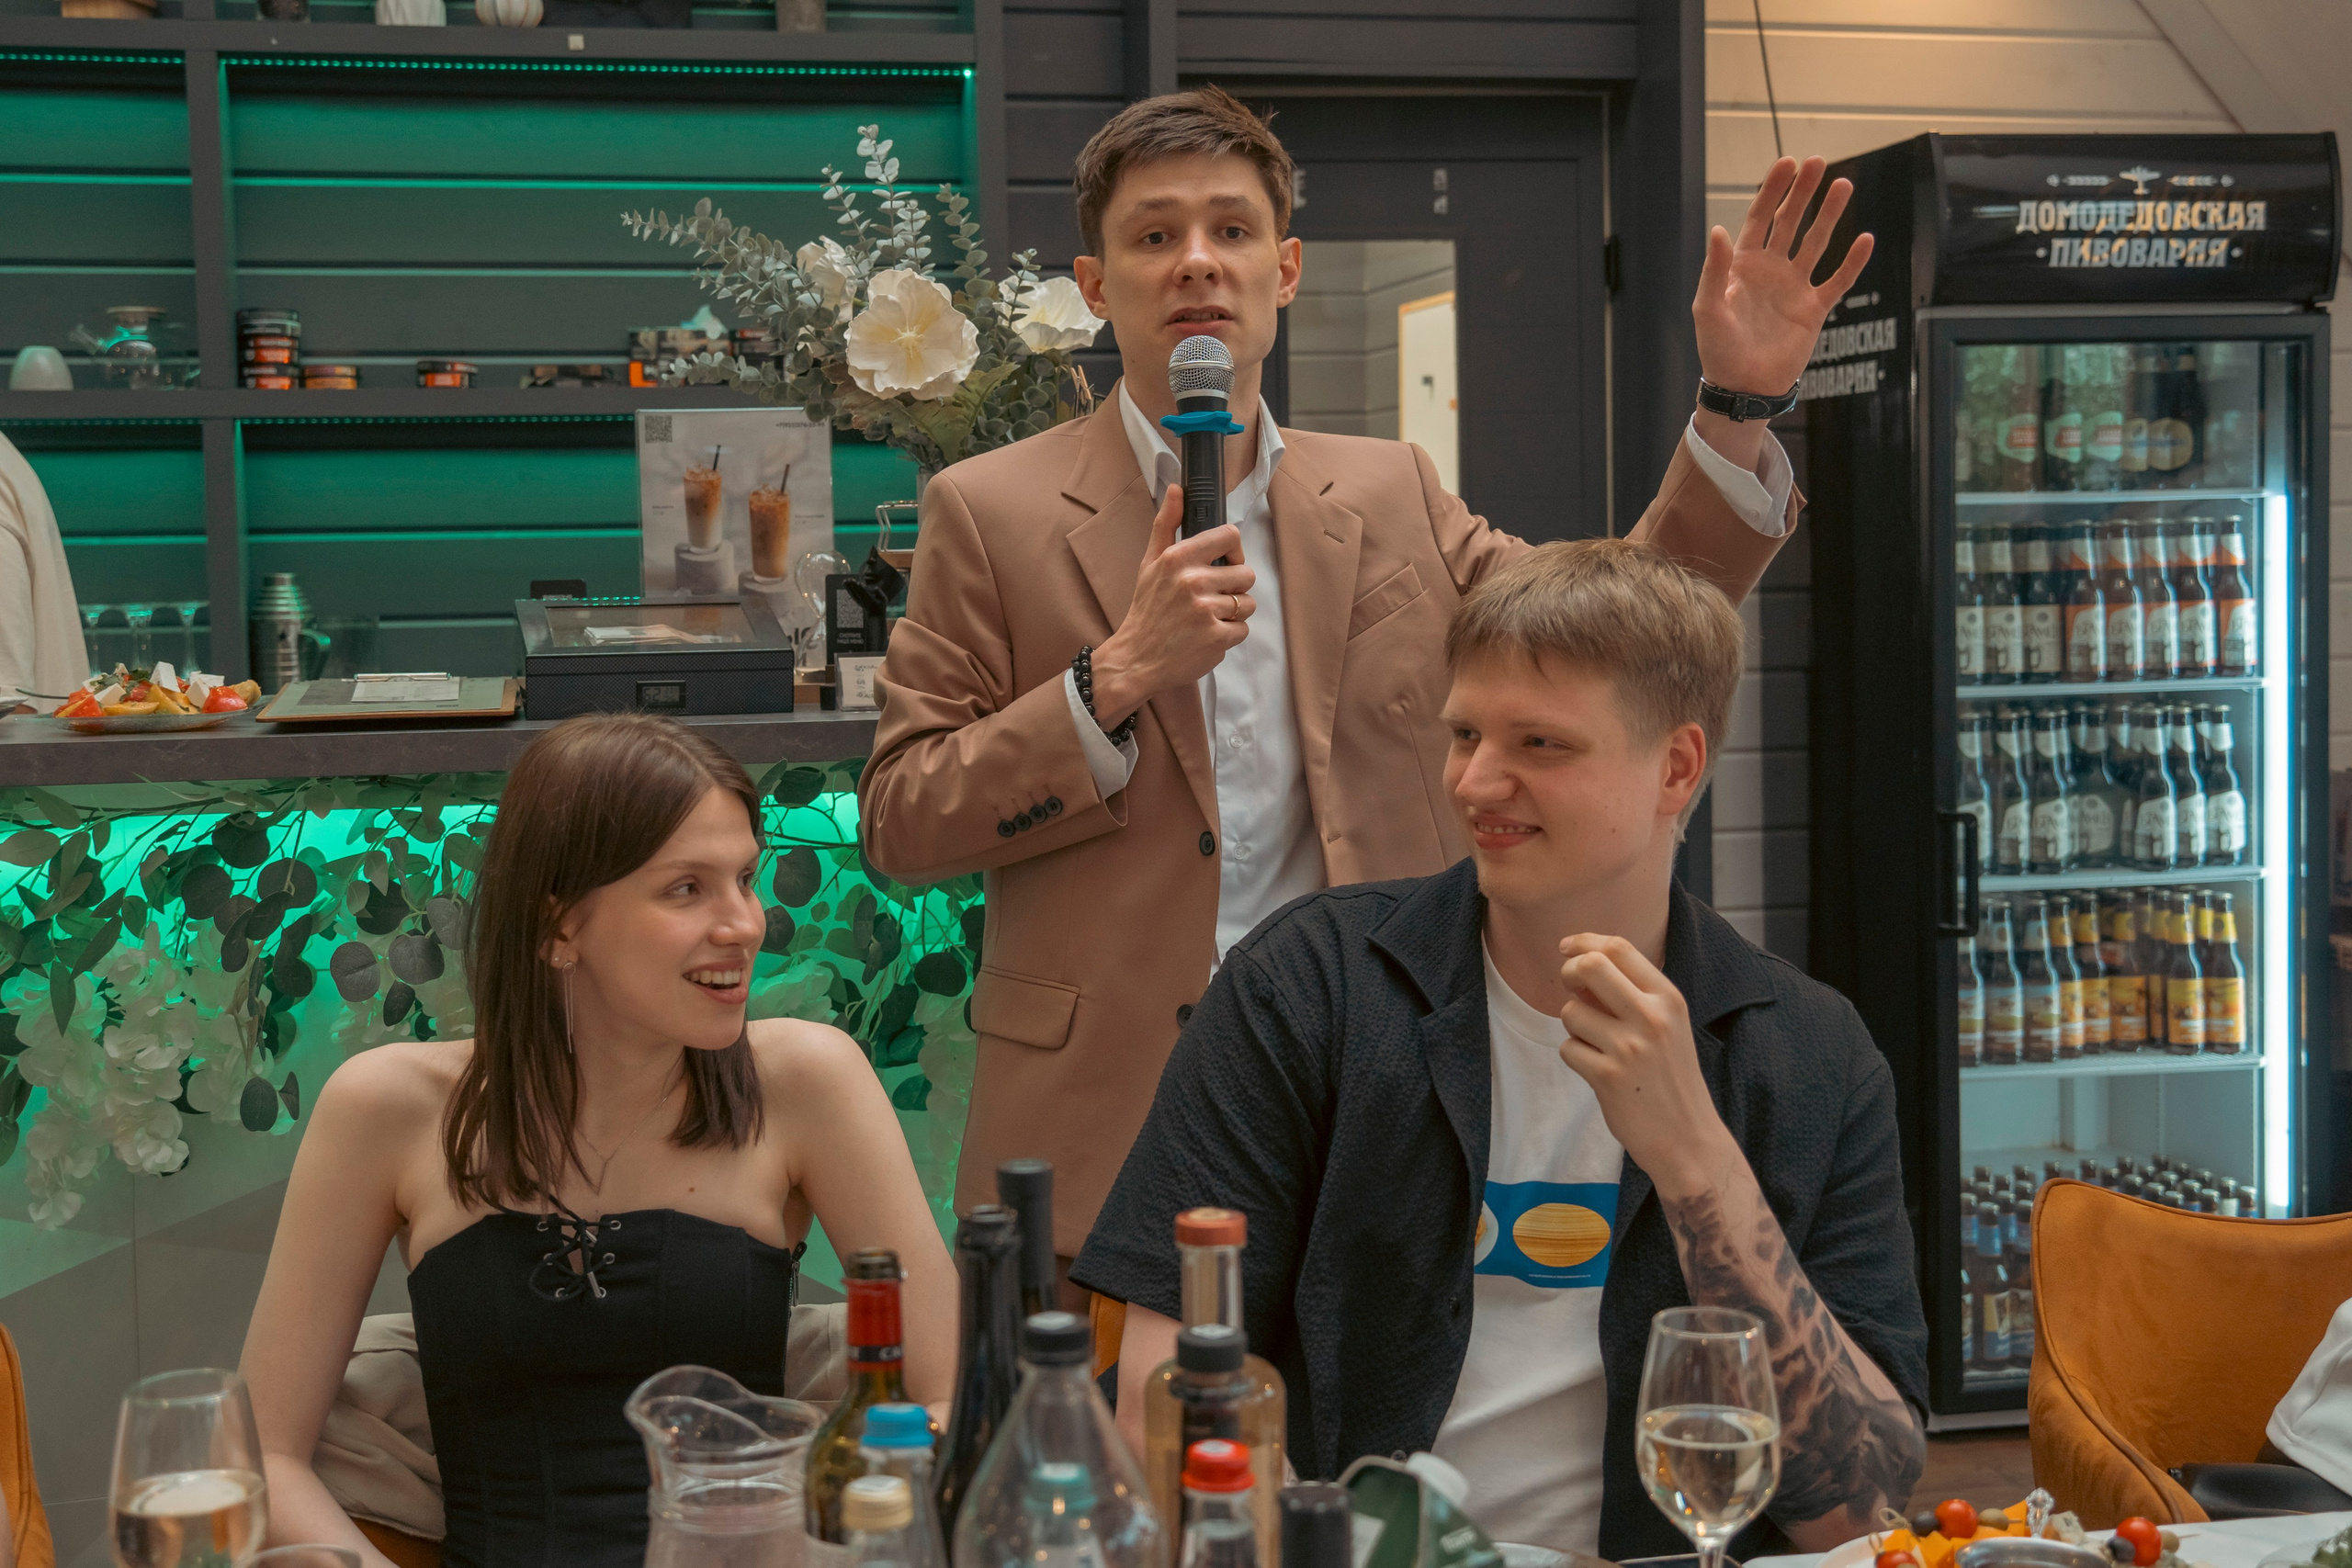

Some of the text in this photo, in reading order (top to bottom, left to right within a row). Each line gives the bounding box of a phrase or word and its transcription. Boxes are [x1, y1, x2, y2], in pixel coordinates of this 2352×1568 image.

[2016, 200, 2267, 234] ДОМОДЕДОВСКАЯ
[2049, 237, 2230, 268] ПИВОВАРНЯ
[1809, 317, 1897, 366] ЕДОВСКАЯ
[1796, 359, 1878, 401] ИВОВАРНЯ
